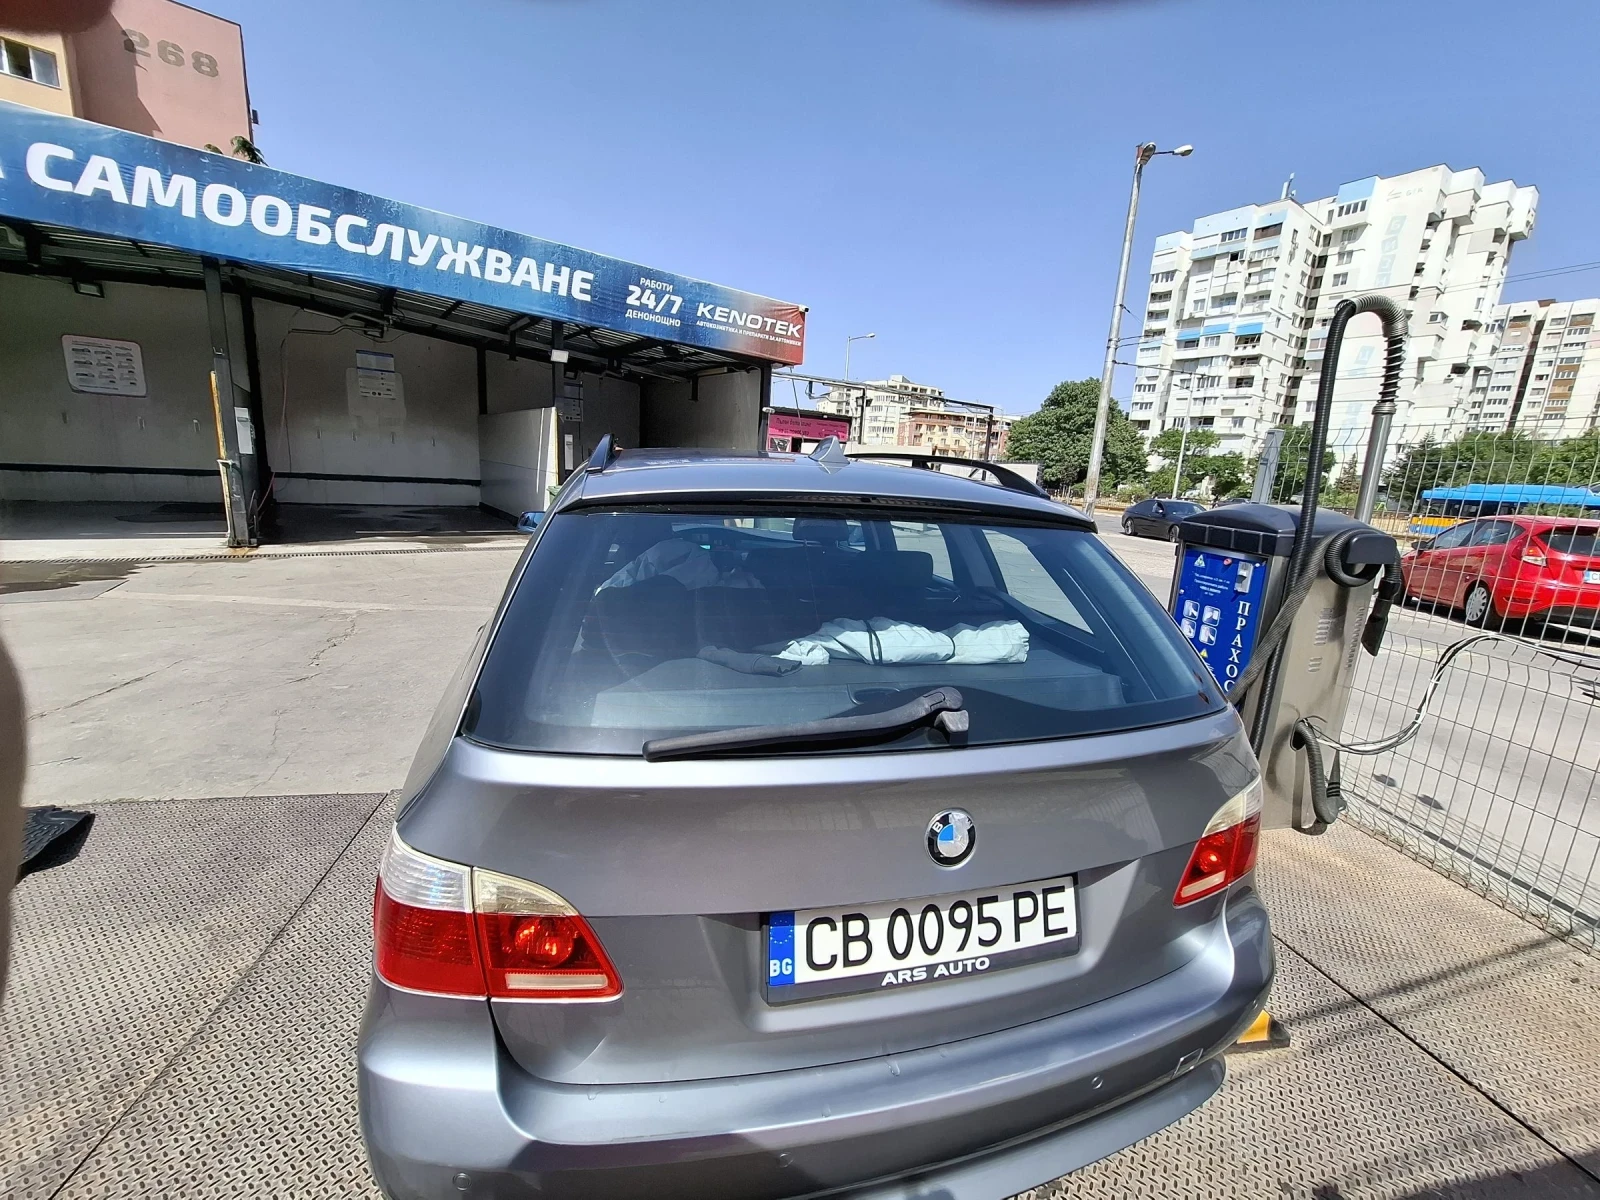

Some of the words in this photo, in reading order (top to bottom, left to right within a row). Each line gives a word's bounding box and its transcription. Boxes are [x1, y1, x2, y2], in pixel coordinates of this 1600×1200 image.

[120, 28, 219, 78] 268
[26, 142, 594, 302] САМООБСЛУЖВАНЕ
[626, 285, 683, 314] 24/7
[640, 277, 673, 293] РАБОТИ
[625, 309, 681, 327] ДЕНОНОЩНО
[696, 302, 803, 338] KENOTEK
[805, 912, 873, 972] CB
[886, 895, 1002, 961] 0095
[1013, 885, 1069, 943] PE
[770, 959, 793, 978] BG
[881, 967, 927, 987] ARS
[933, 956, 990, 979] AUTO
